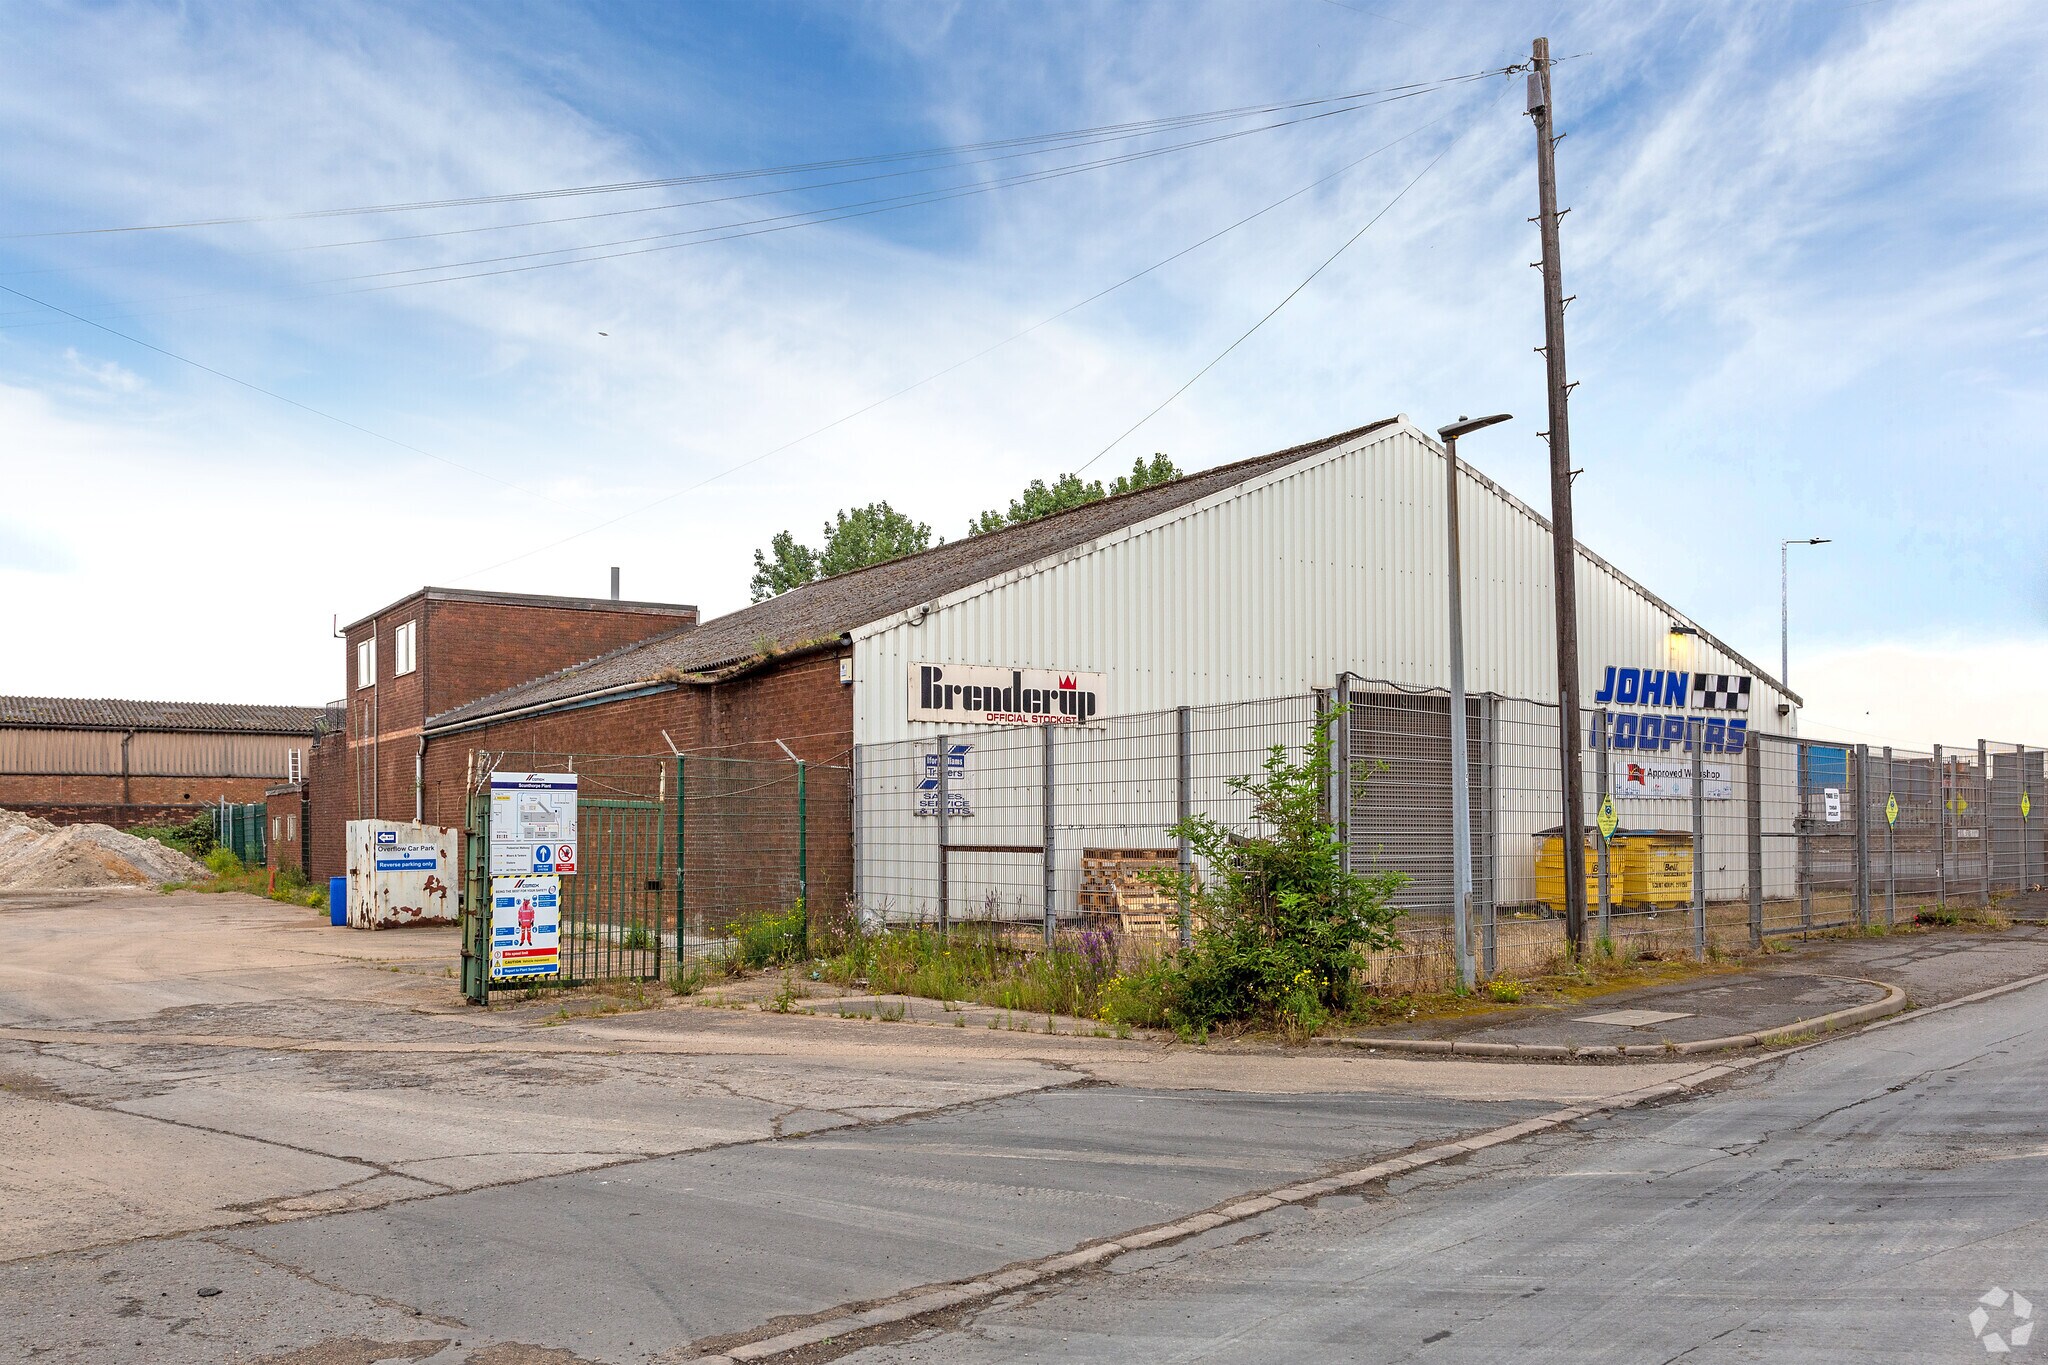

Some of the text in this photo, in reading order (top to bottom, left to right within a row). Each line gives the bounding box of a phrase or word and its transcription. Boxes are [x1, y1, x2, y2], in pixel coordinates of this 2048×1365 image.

[1594, 665, 1690, 708] JOHN
[920, 665, 1096, 725] Brenderup
[986, 713, 1077, 725] OFFICIAL STOCKIST
[928, 768, 962, 776] Trers
[1647, 768, 1721, 780] Approved Wshop
